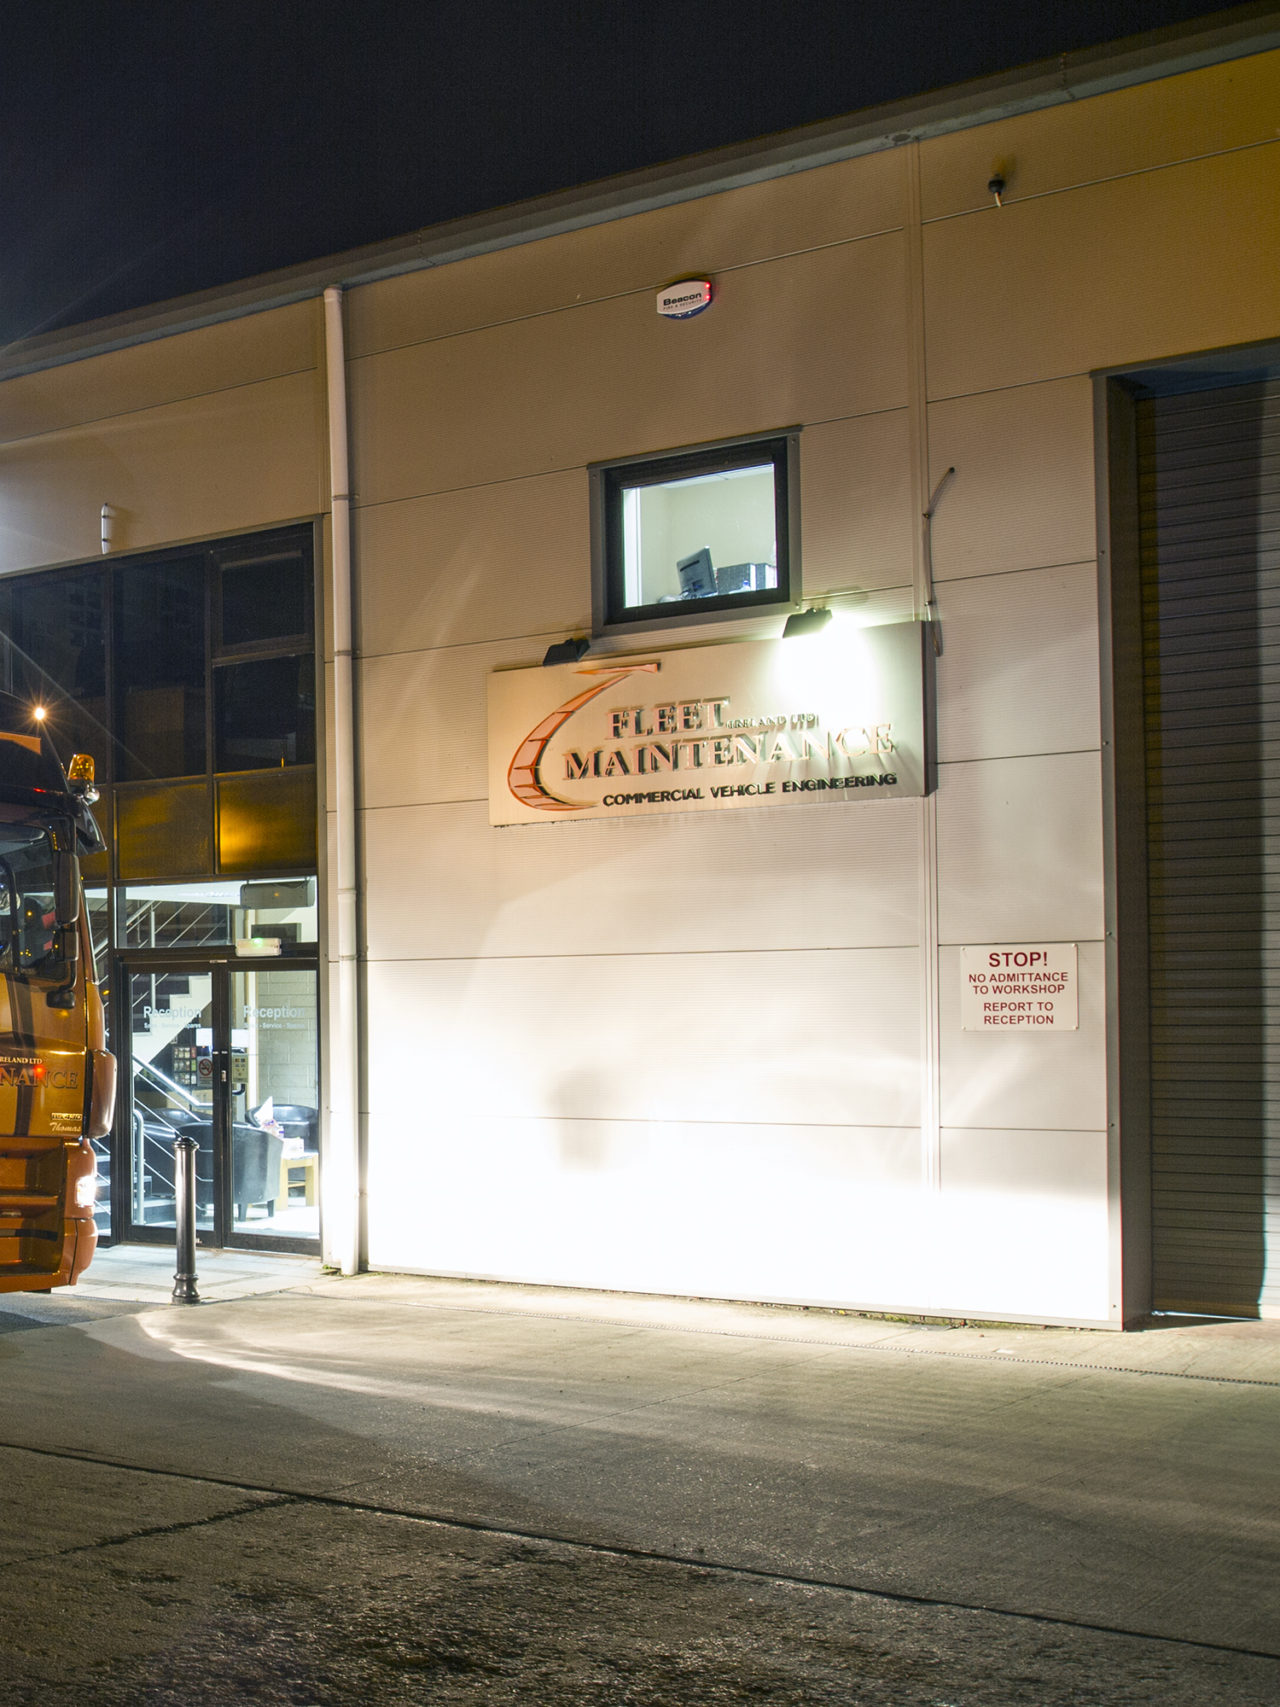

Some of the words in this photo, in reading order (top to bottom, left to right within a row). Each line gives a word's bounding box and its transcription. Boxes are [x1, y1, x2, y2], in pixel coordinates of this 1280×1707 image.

[663, 292, 702, 306] Beacon
[605, 697, 730, 741] FLEET
[562, 722, 893, 780] MAINTENANCE
[603, 787, 705, 807] COMMERCIAL
[710, 782, 776, 798] VEHICLE
[782, 773, 897, 793] ENGINEERING
[988, 951, 1048, 968] STOP!
[968, 973, 986, 983] NO
[989, 972, 1069, 983] ADMITTANCE
[973, 985, 989, 995] TO
[992, 984, 1065, 994] WORKSHOP
[143, 1005, 202, 1020] Reception
[243, 1003, 305, 1021] Reception
[983, 1002, 1033, 1012] REPORT
[1037, 1002, 1054, 1011] TO
[983, 1015, 1054, 1025] RECEPTION
